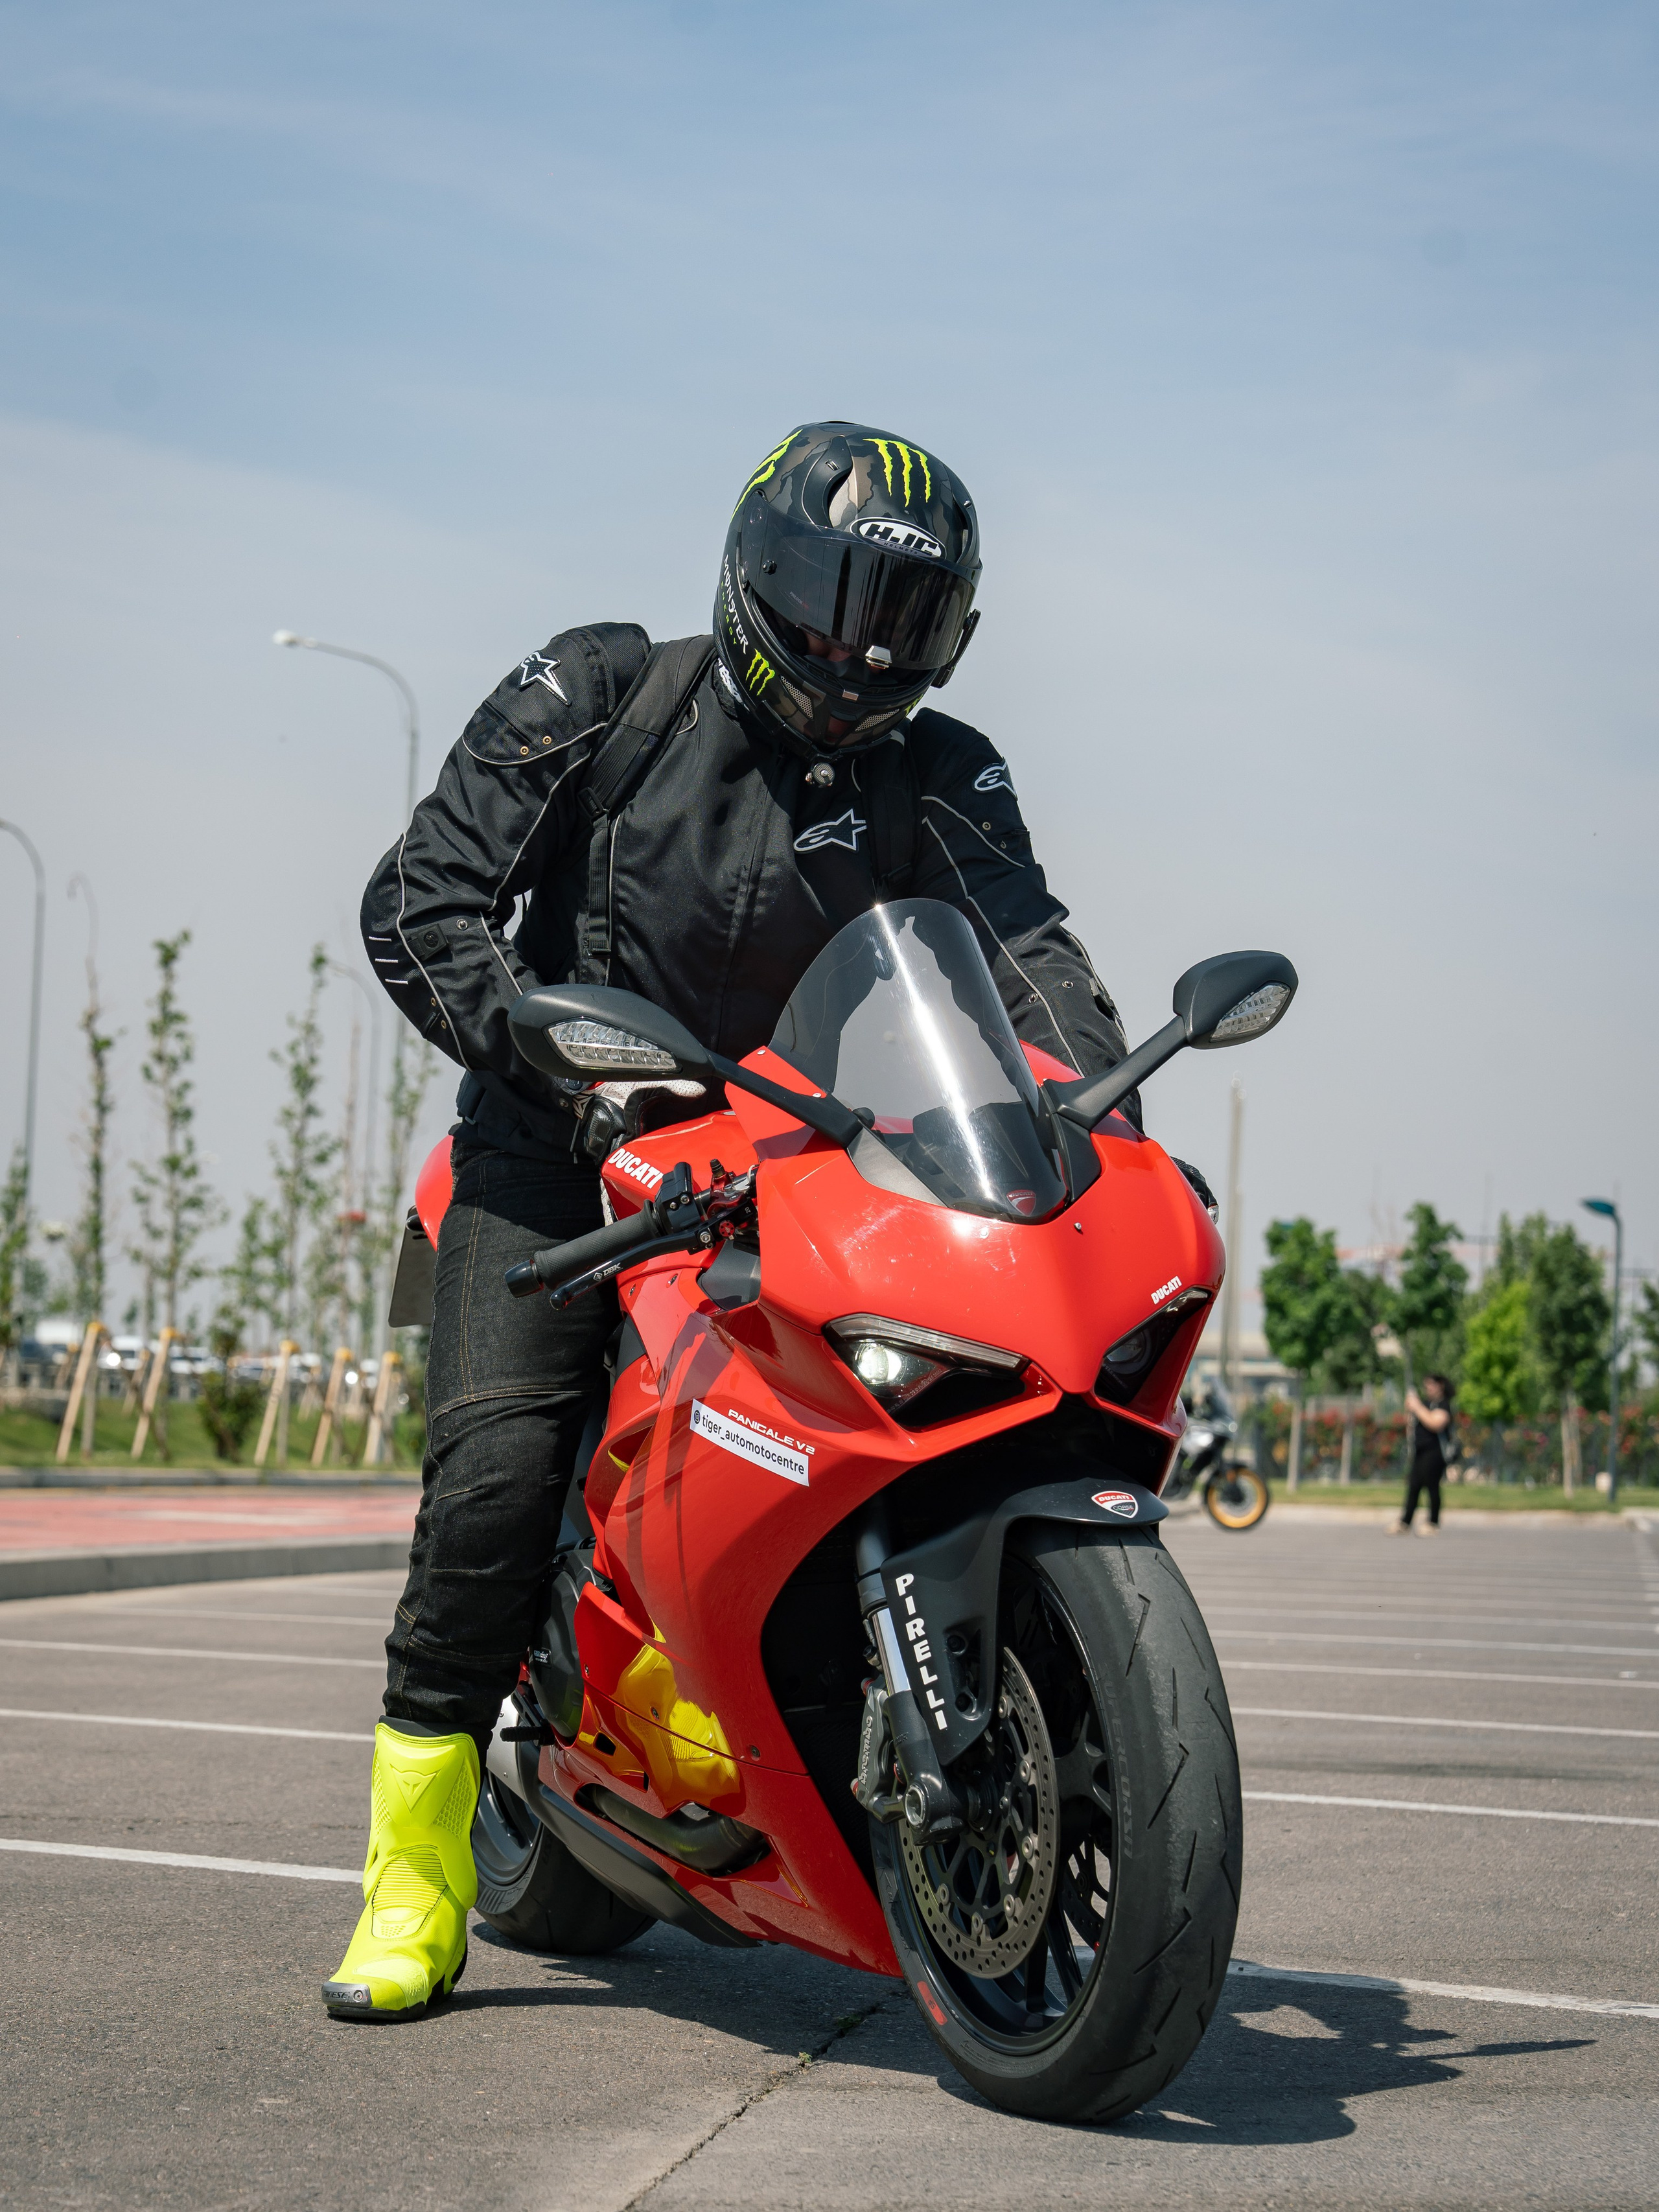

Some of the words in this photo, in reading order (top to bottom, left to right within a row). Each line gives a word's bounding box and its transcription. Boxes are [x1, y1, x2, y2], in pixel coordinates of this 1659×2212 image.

[863, 523, 938, 557] HJC
[883, 542, 918, 555] HELMETS
[723, 554, 748, 655] MONSTER
[607, 1148, 664, 1189] DUCATI
[603, 1262, 621, 1276] DBK
[1150, 1275, 1182, 1305] DUCATI
[702, 1414, 805, 1475] tiger_automotocentre
[728, 1408, 795, 1447] PANIGALE
[796, 1440, 815, 1456] V2
[895, 1573, 948, 1730] PIRELLI
[857, 1716, 873, 1786] brembo
